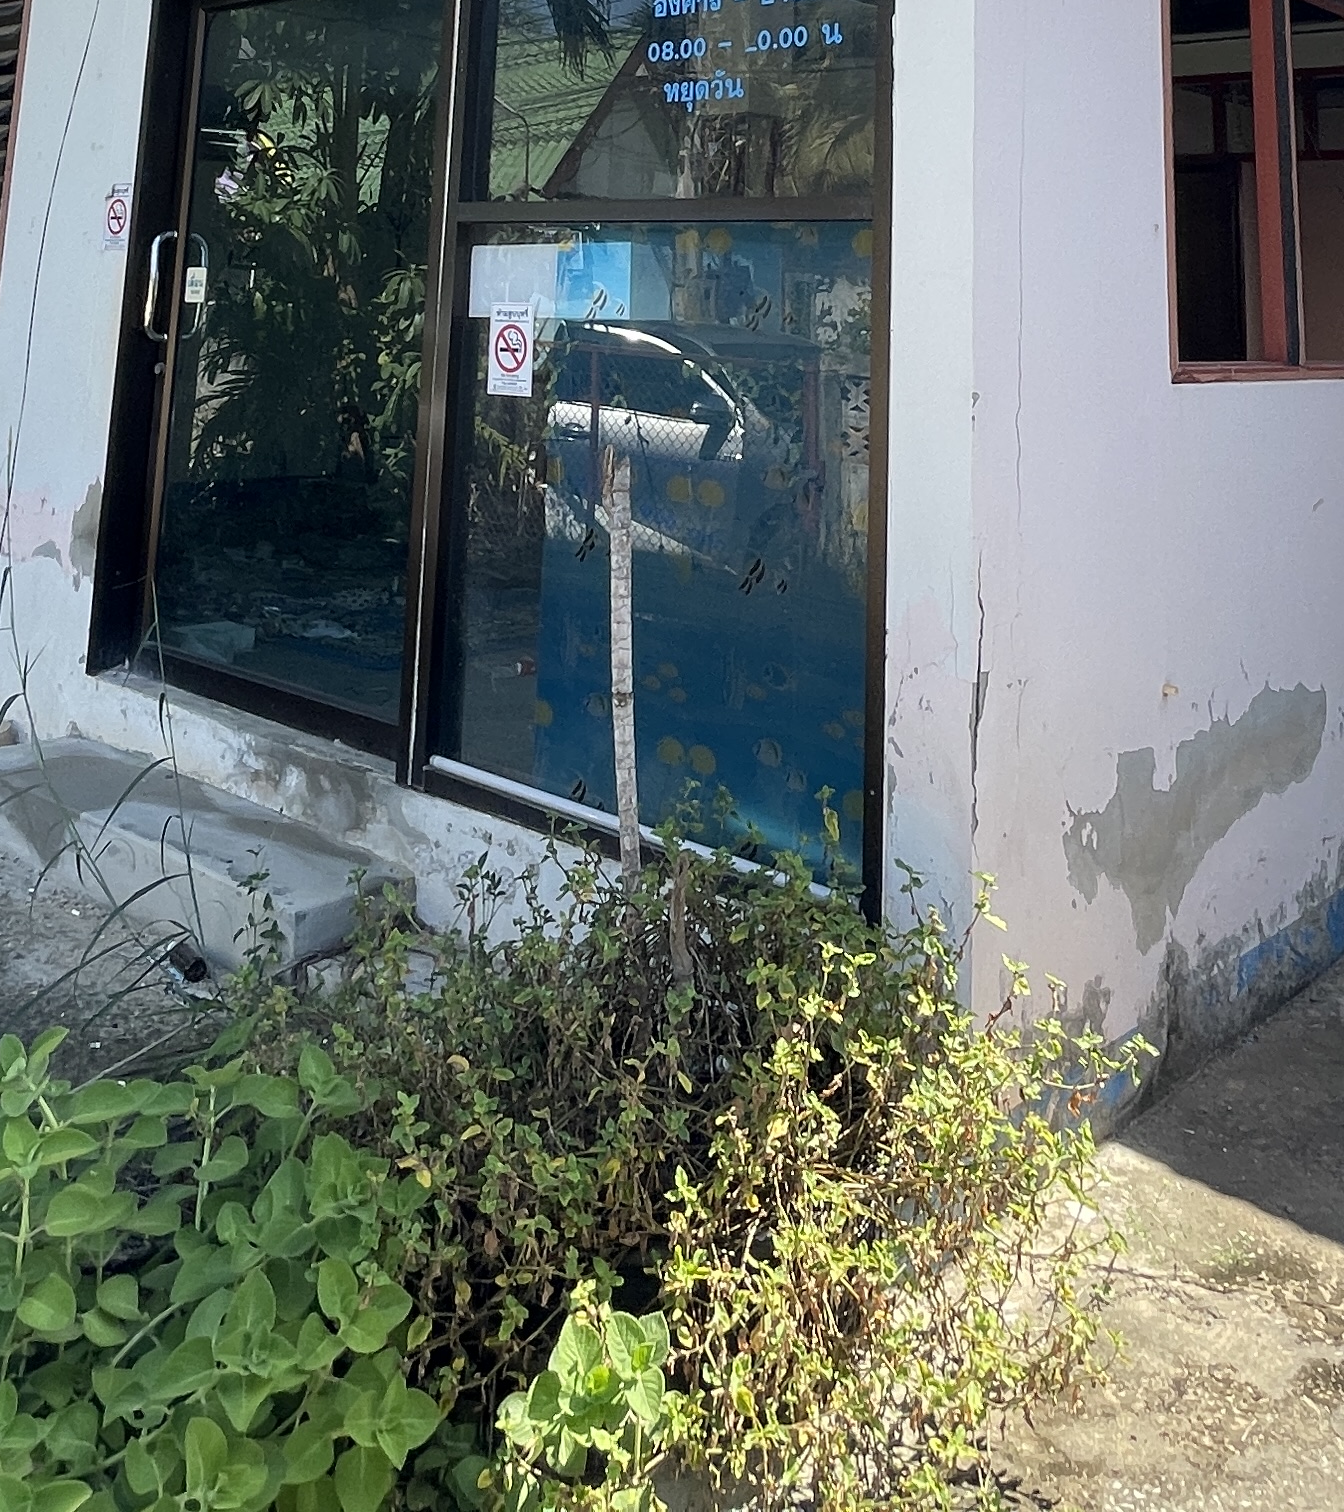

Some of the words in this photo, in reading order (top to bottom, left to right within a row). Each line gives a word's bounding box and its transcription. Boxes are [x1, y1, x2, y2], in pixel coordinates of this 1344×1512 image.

[647, 38, 706, 62] 08.00
[745, 26, 808, 53] 0.00
[664, 70, 744, 112] หยุดวัน
